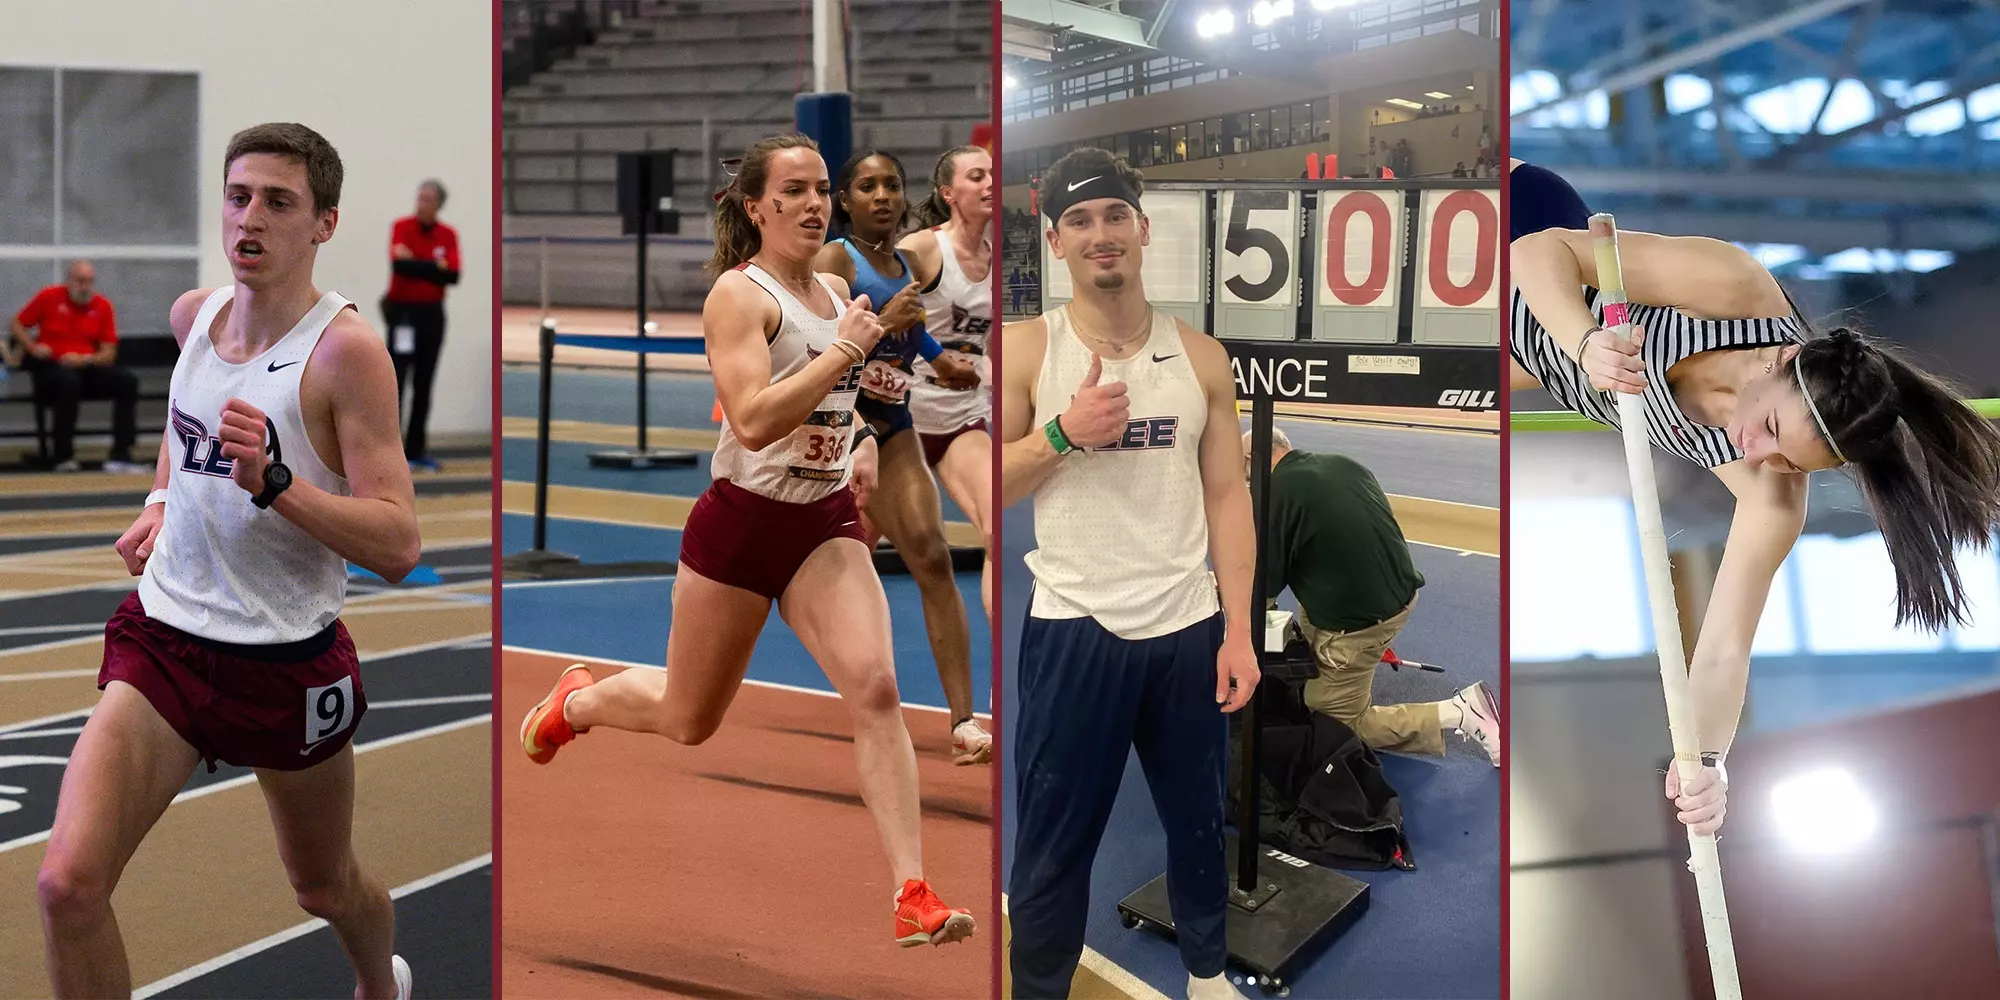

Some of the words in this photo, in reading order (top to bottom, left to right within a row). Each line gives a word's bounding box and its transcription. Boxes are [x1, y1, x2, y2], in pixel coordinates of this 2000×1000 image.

[1218, 158, 1225, 171] 3
[831, 363, 865, 393] EE
[1437, 389, 1496, 408] GILL
[1094, 416, 1178, 451] EE
[804, 434, 846, 464] 336
[316, 686, 345, 738] 9
[1265, 849, 1310, 868] GILL
